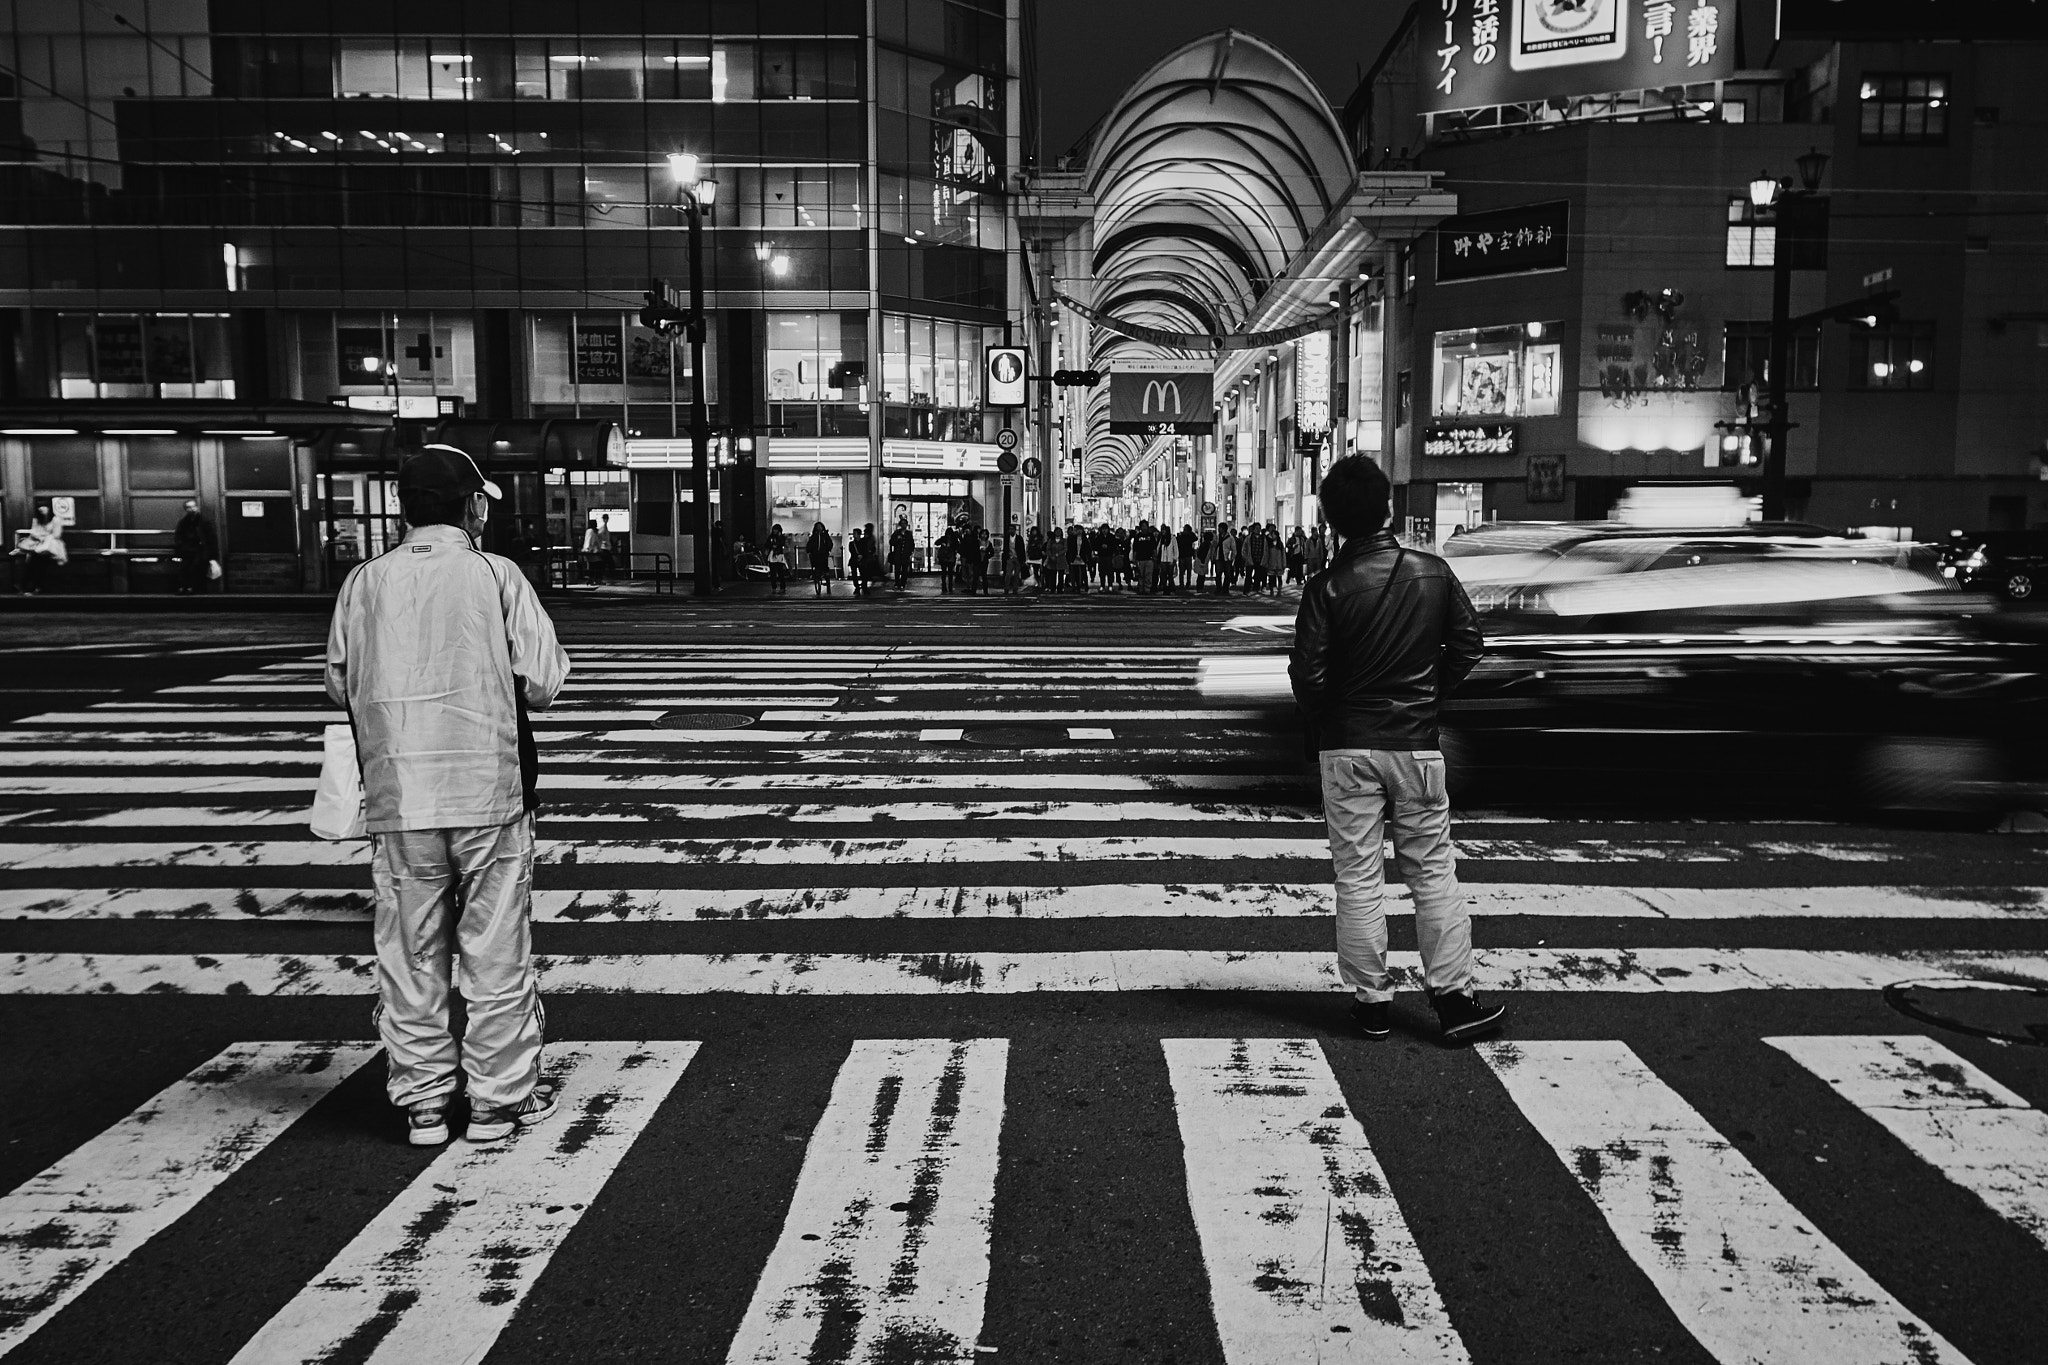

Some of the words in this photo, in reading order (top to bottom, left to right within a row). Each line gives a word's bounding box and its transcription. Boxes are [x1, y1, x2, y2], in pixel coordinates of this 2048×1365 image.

[1643, 0, 1676, 64] 言!
[1687, 0, 1719, 67] 業界
[1115, 321, 1188, 347] HIROSHIMA
[1000, 434, 1014, 446] 20
[1159, 423, 1176, 435] 24
